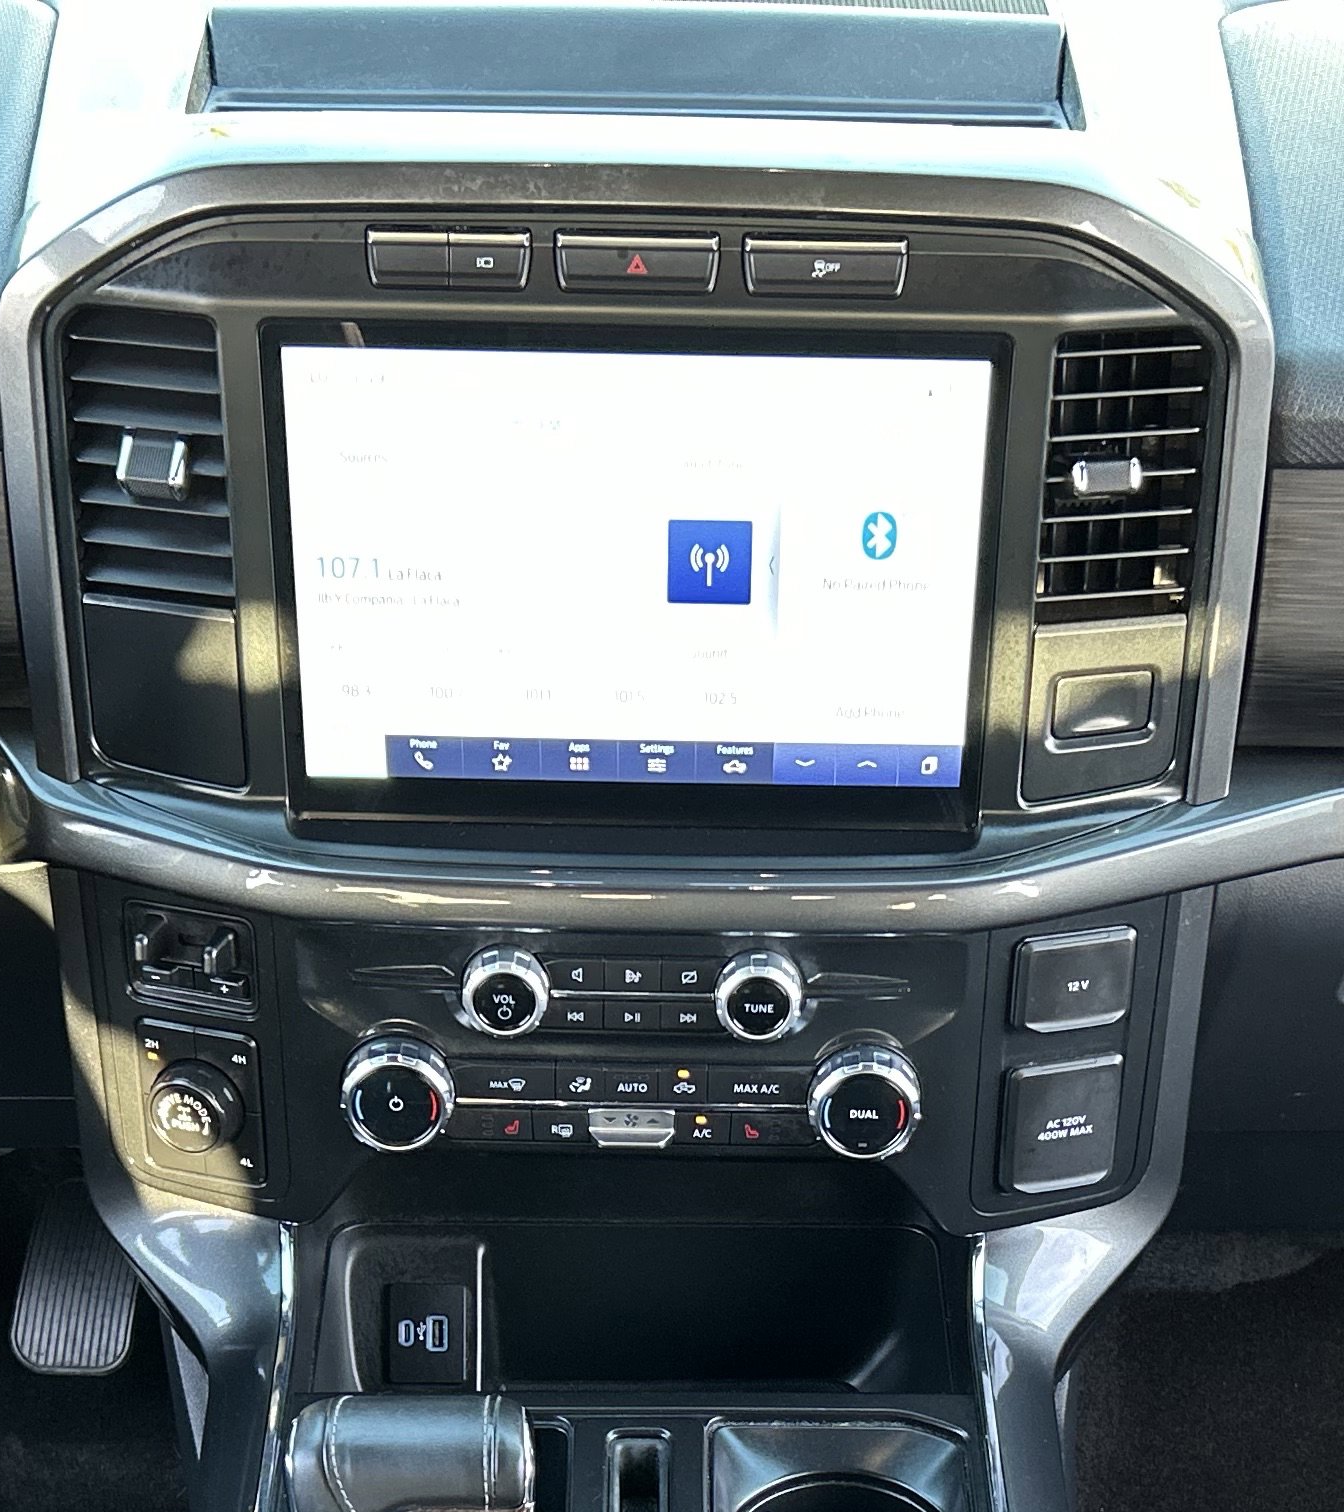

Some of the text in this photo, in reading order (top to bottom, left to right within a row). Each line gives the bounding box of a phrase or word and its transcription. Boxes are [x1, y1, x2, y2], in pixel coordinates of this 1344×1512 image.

[704, 692, 738, 705] 1025
[409, 738, 438, 750] Phone
[493, 740, 511, 750] Fav
[568, 742, 592, 754] Apps
[639, 743, 675, 756] Settings
[716, 744, 755, 756] Features
[492, 993, 516, 1005] VOL
[743, 1002, 775, 1014] TUNE
[144, 1038, 160, 1050] 2H
[231, 1054, 247, 1065] 4H
[489, 1080, 509, 1090] MAX
[617, 1082, 648, 1093] AUTO
[733, 1083, 781, 1095] MAX A/C
[849, 1108, 879, 1120] DUAL
[1046, 1114, 1087, 1130] AC 120V
[692, 1128, 712, 1139] A/C
[1037, 1123, 1094, 1142] 400W MAX
[239, 1157, 254, 1168] 4L
